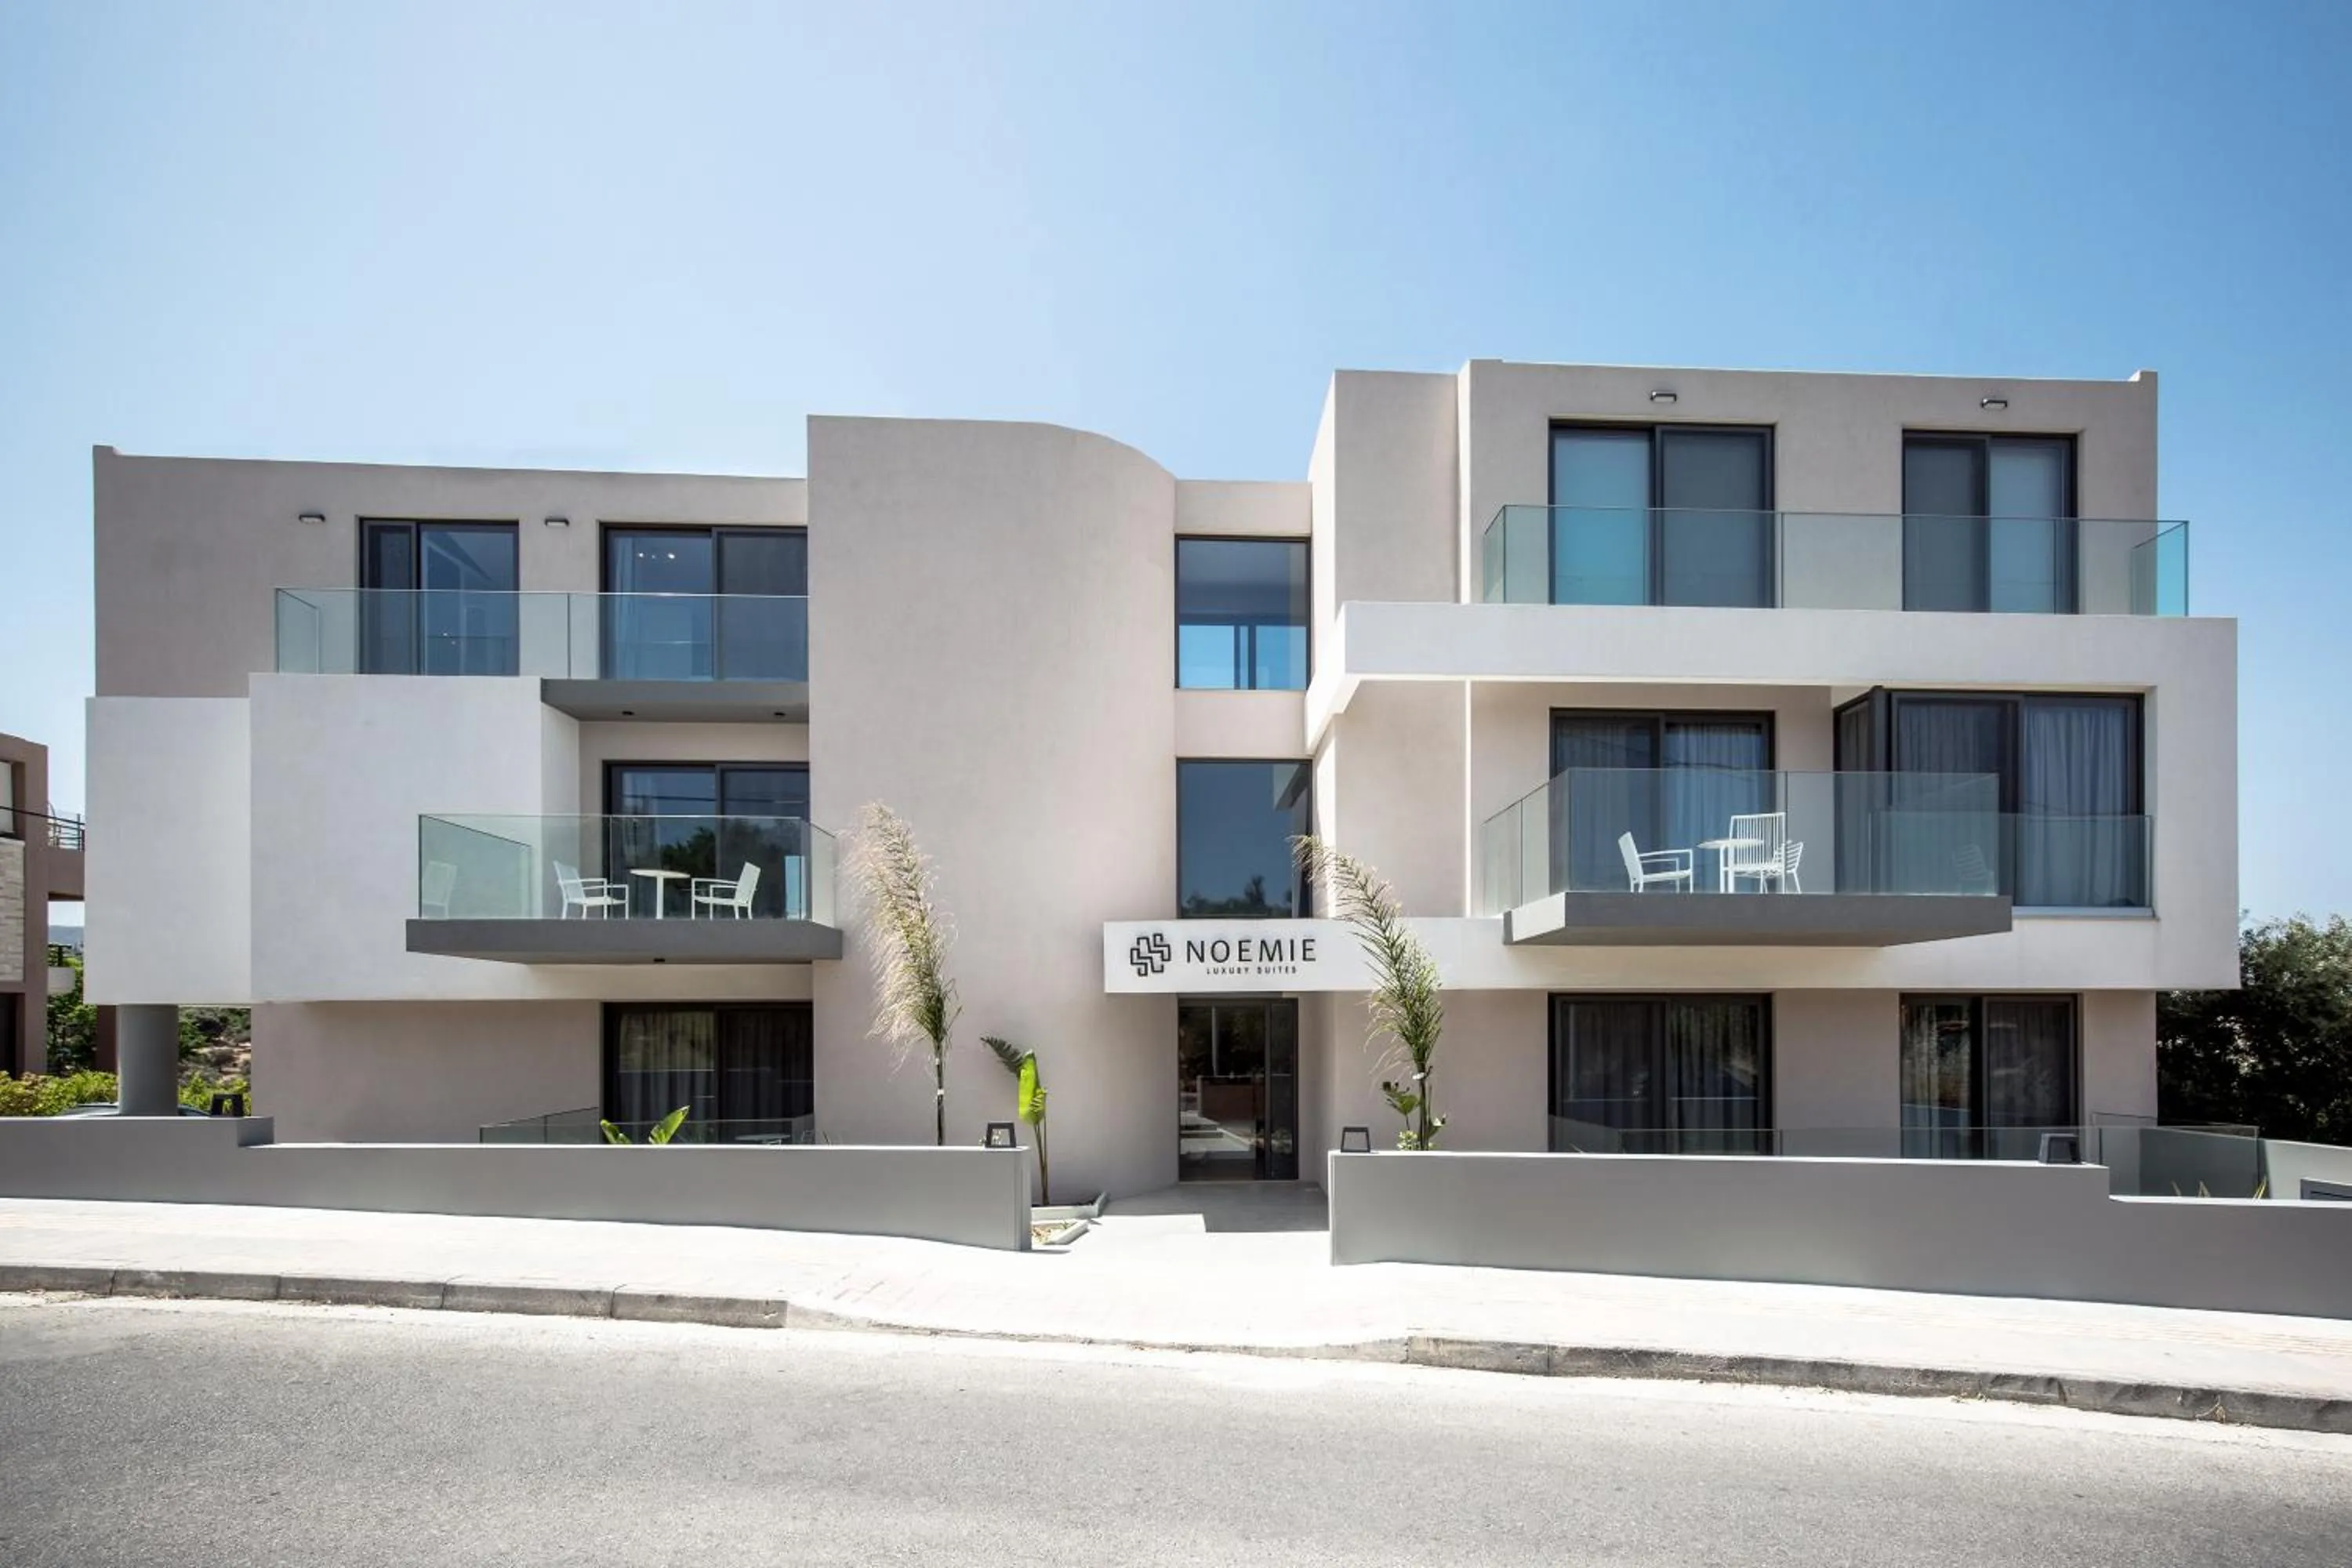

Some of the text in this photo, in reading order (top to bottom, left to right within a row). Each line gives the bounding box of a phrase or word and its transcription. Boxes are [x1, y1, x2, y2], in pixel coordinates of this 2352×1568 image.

[1186, 938, 1316, 964] NOEMIE
[1206, 966, 1297, 975] LUXURY SUITES
